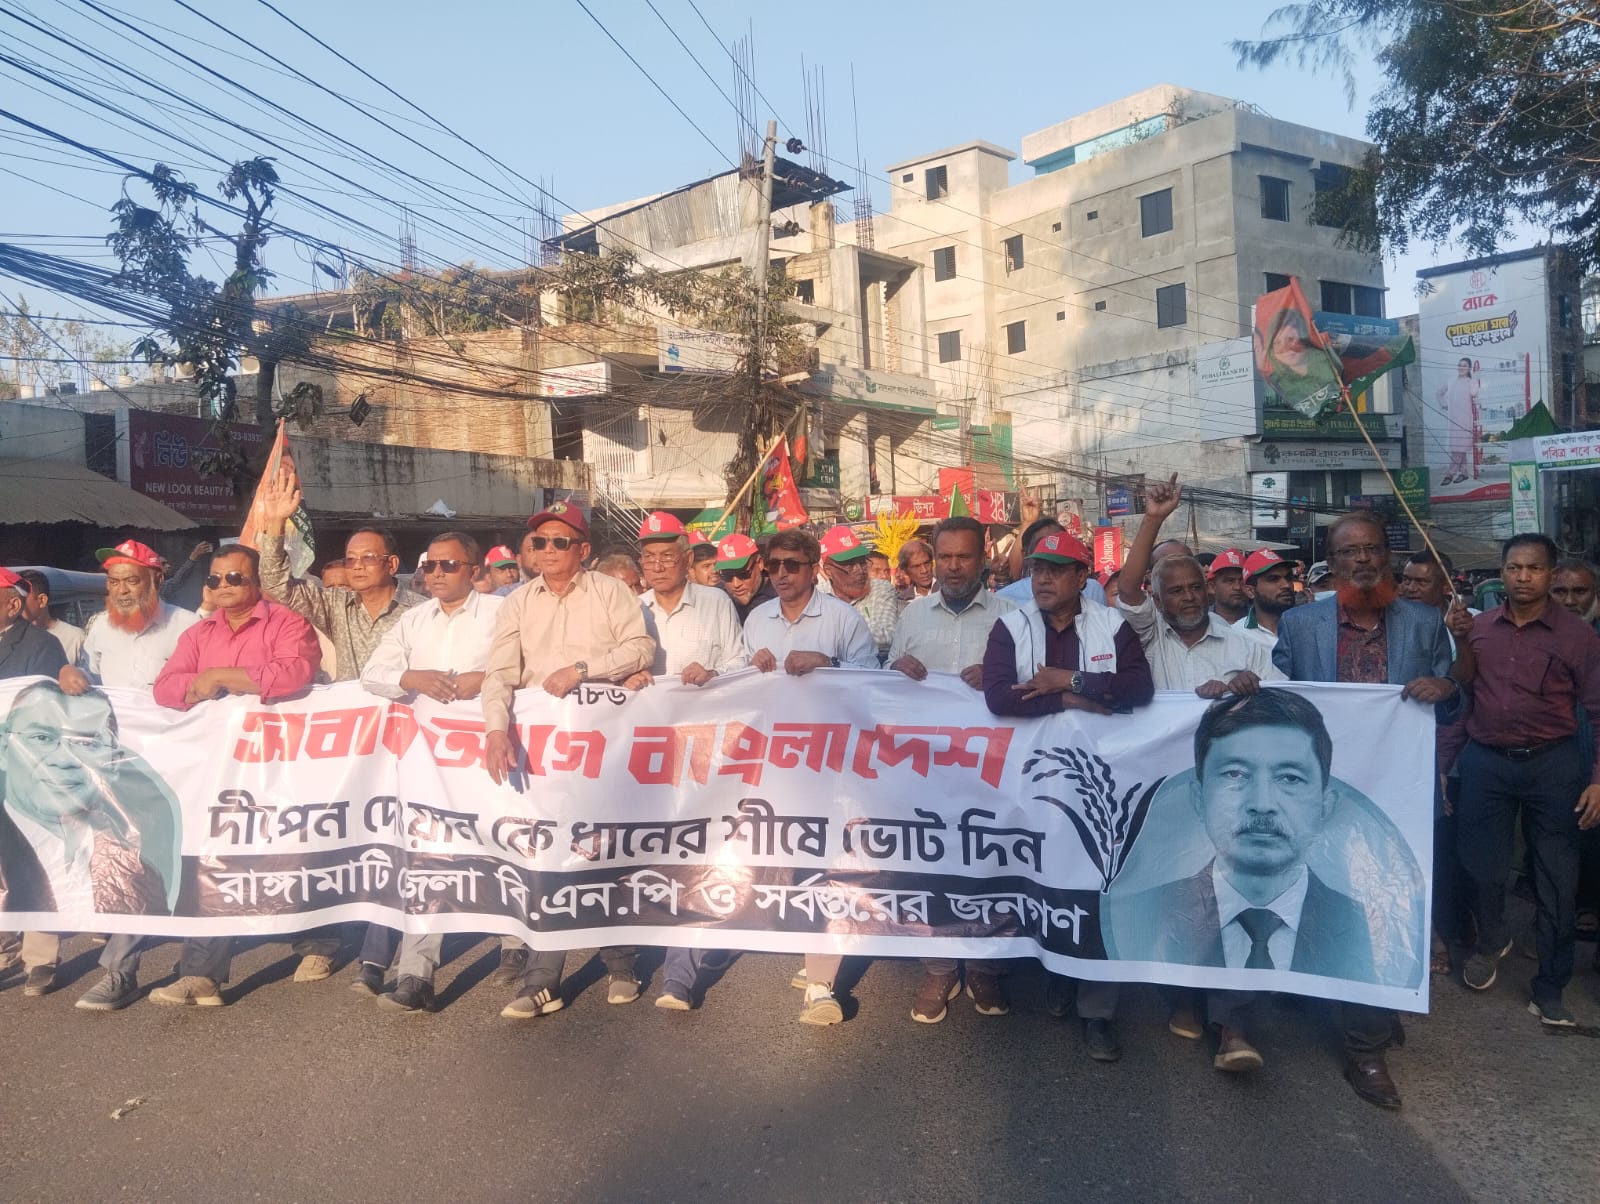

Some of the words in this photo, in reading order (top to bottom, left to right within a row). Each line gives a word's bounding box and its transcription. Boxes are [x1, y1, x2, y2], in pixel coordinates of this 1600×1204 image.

[154, 430, 188, 468] নিউ
[1542, 447, 1566, 460] পবিত্র
[145, 482, 165, 493] NEW
[168, 484, 192, 495] LOOK
[195, 485, 223, 497] BEAUTY
[628, 721, 1014, 788] বাংলাদেশ
[208, 789, 350, 845] দীপেন
[492, 816, 557, 860] কে
[570, 817, 712, 861] ধানের
[722, 798, 829, 857] শীষে
[843, 808, 947, 862] ভোট
[958, 808, 1046, 873] দিন
[211, 849, 393, 906] রাঙ্গামাটি
[397, 867, 485, 903] জেলা
[700, 884, 736, 914] ও
[944, 893, 1090, 945] জনগণ
